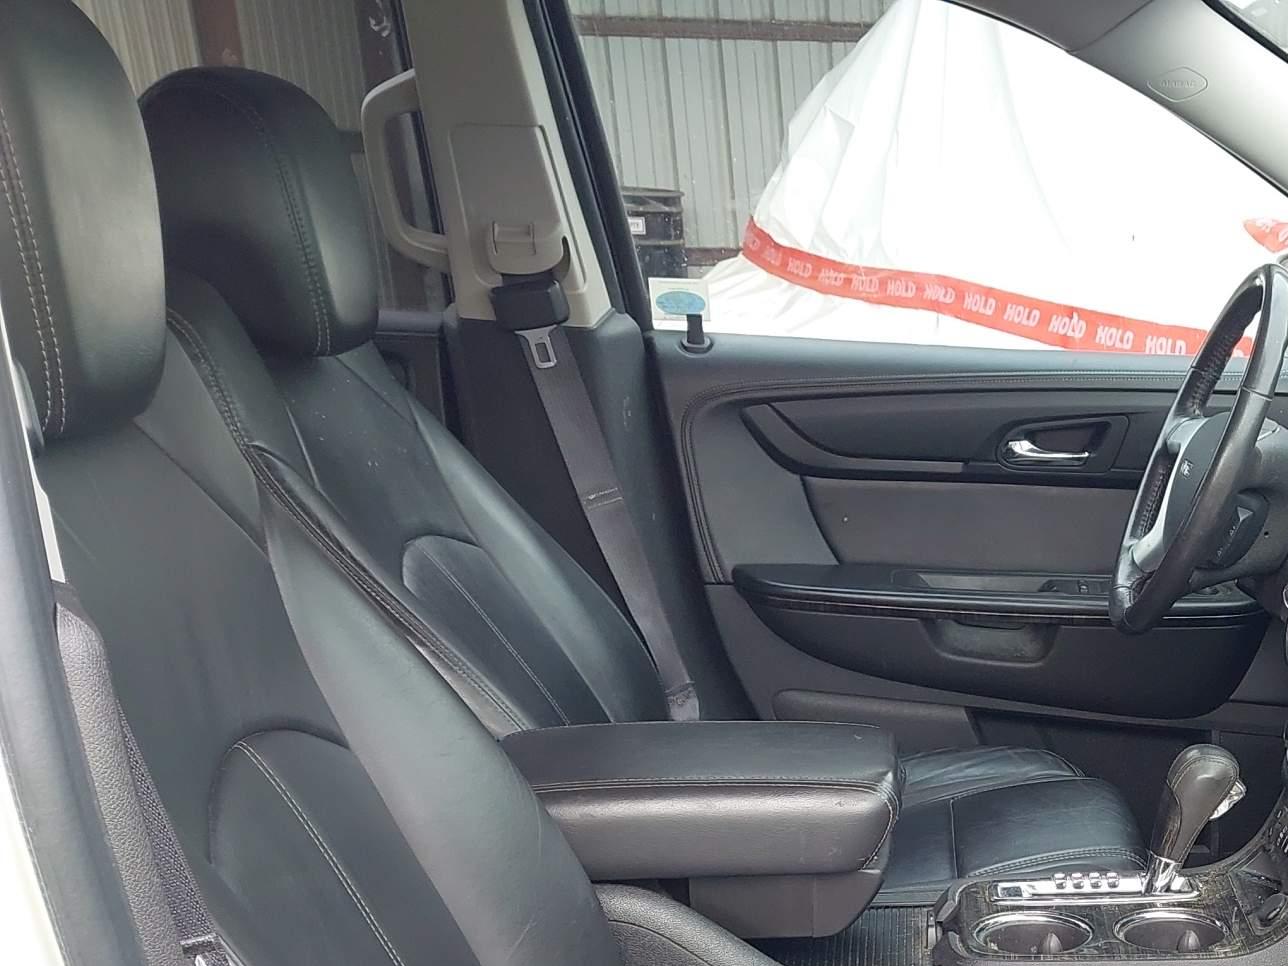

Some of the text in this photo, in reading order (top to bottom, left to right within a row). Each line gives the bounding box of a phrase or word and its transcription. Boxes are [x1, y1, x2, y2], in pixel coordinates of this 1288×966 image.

[887, 278, 916, 298] HOLD
[923, 282, 956, 304] HOLD
[964, 292, 996, 315] HOLD
[1004, 304, 1041, 327] HOLD
[1048, 312, 1087, 338] HOLD
[1096, 325, 1134, 349] HOLD
[1146, 335, 1187, 355] HOLD
